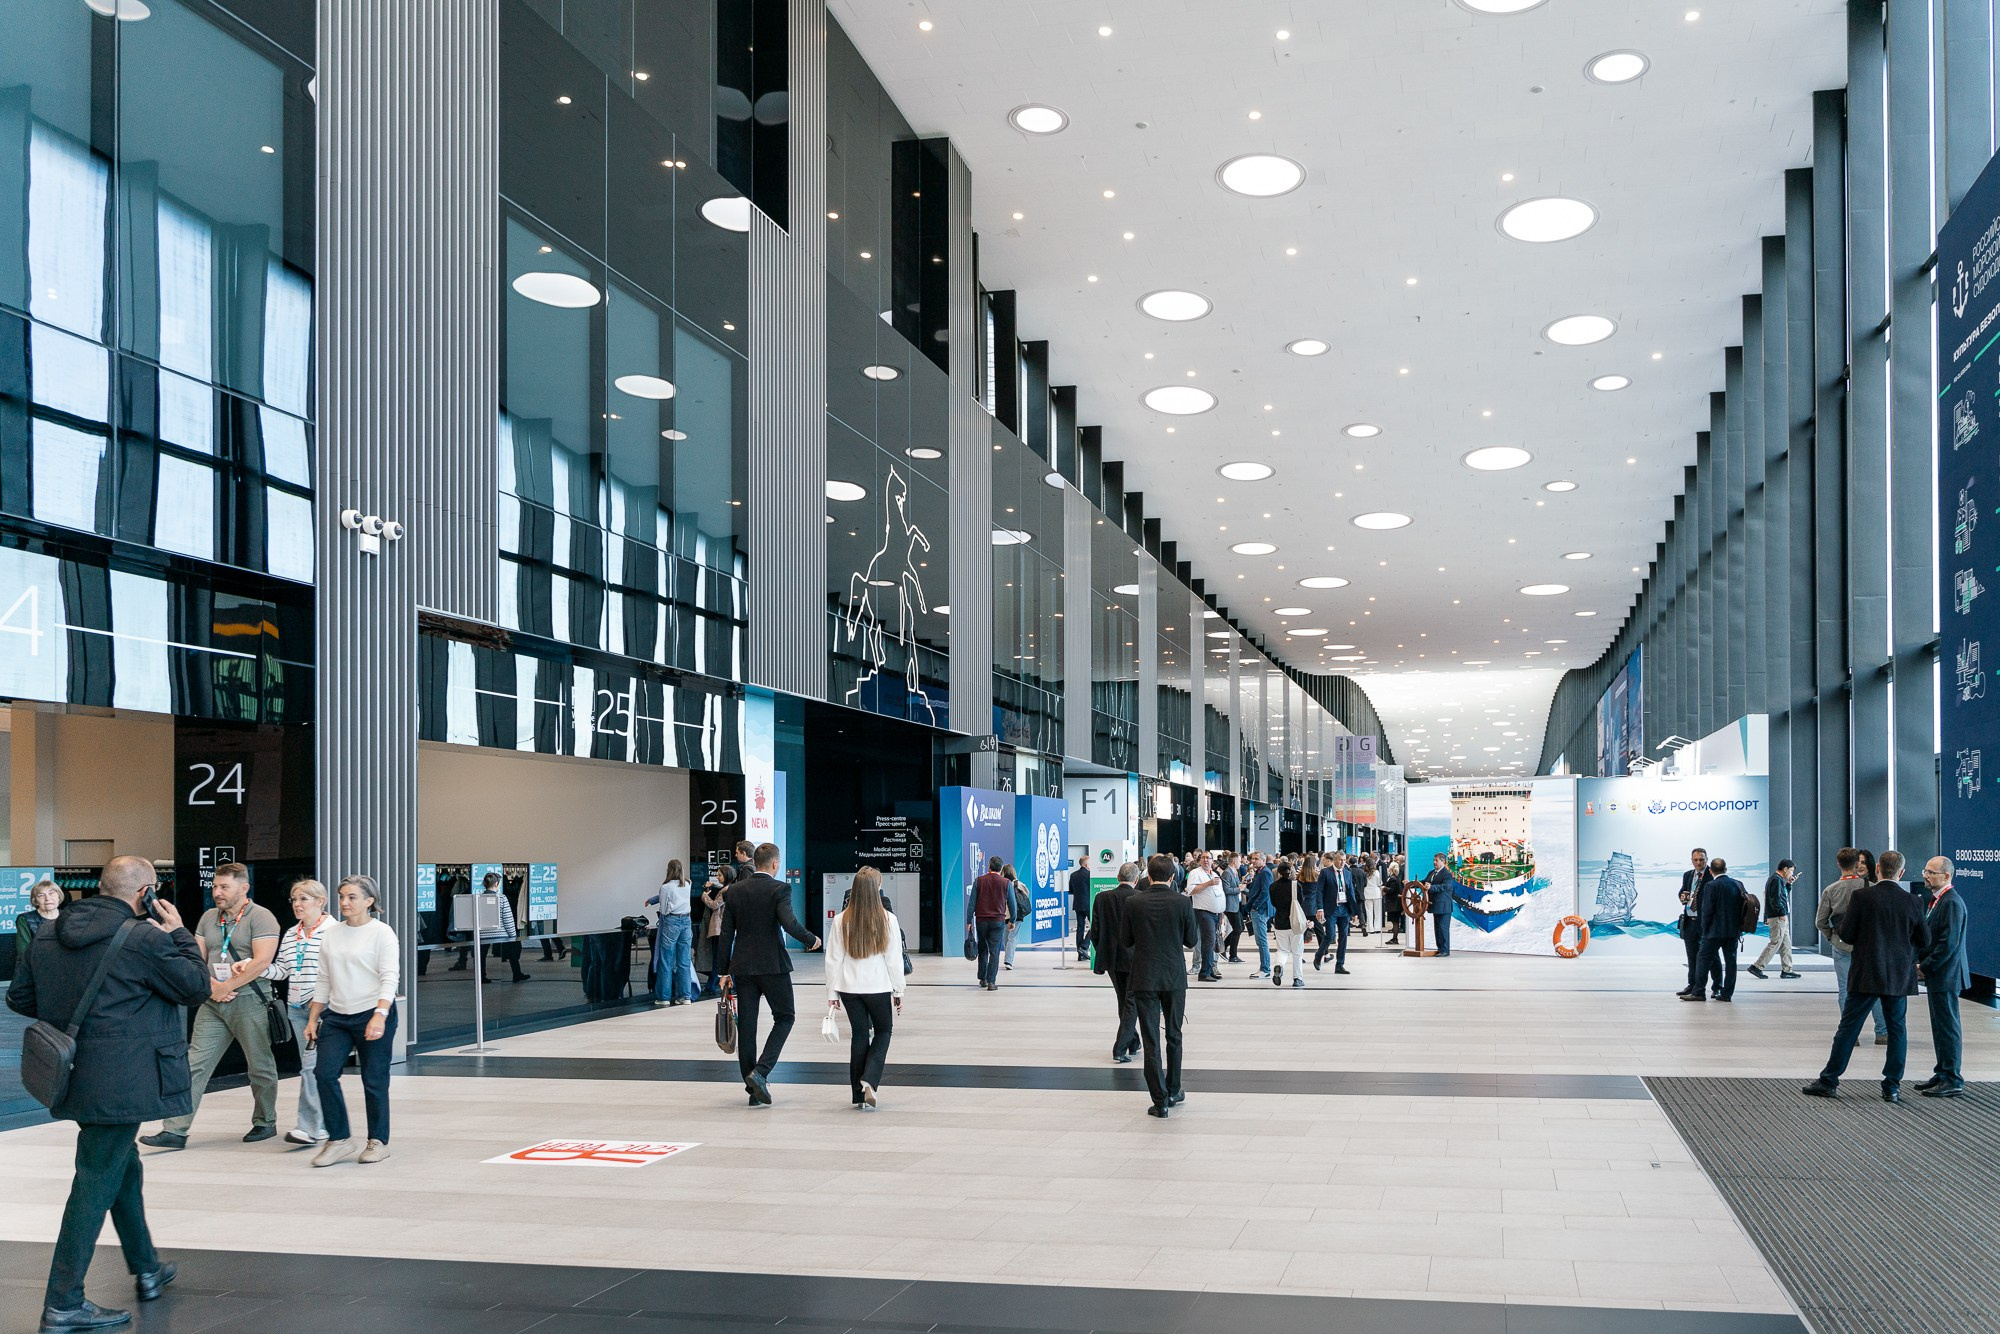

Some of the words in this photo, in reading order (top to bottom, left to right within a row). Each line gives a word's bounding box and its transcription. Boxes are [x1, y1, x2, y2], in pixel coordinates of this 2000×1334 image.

[1973, 254, 2000, 298] СУДОХОД
[597, 689, 632, 737] 25
[1360, 737, 1371, 752] G
[188, 762, 246, 806] 24
[1002, 776, 1012, 793] 26
[1050, 784, 1059, 799] 27
[700, 800, 739, 825] 25
[1670, 800, 1760, 811] РОСМОРПОРТ
[752, 817, 769, 829] NEVA
[199, 847, 211, 866] F
[708, 850, 716, 863] F
[1955, 849, 1960, 861] 8
[1960, 849, 1972, 861] 800
[1972, 849, 1985, 862] 333
[1985, 849, 1994, 862] 99
[417, 867, 435, 885] 25
[531, 865, 535, 876] F
[543, 866, 557, 881] 25
[535, 1141, 608, 1151] НЕВА
[618, 1143, 686, 1153] 2025
